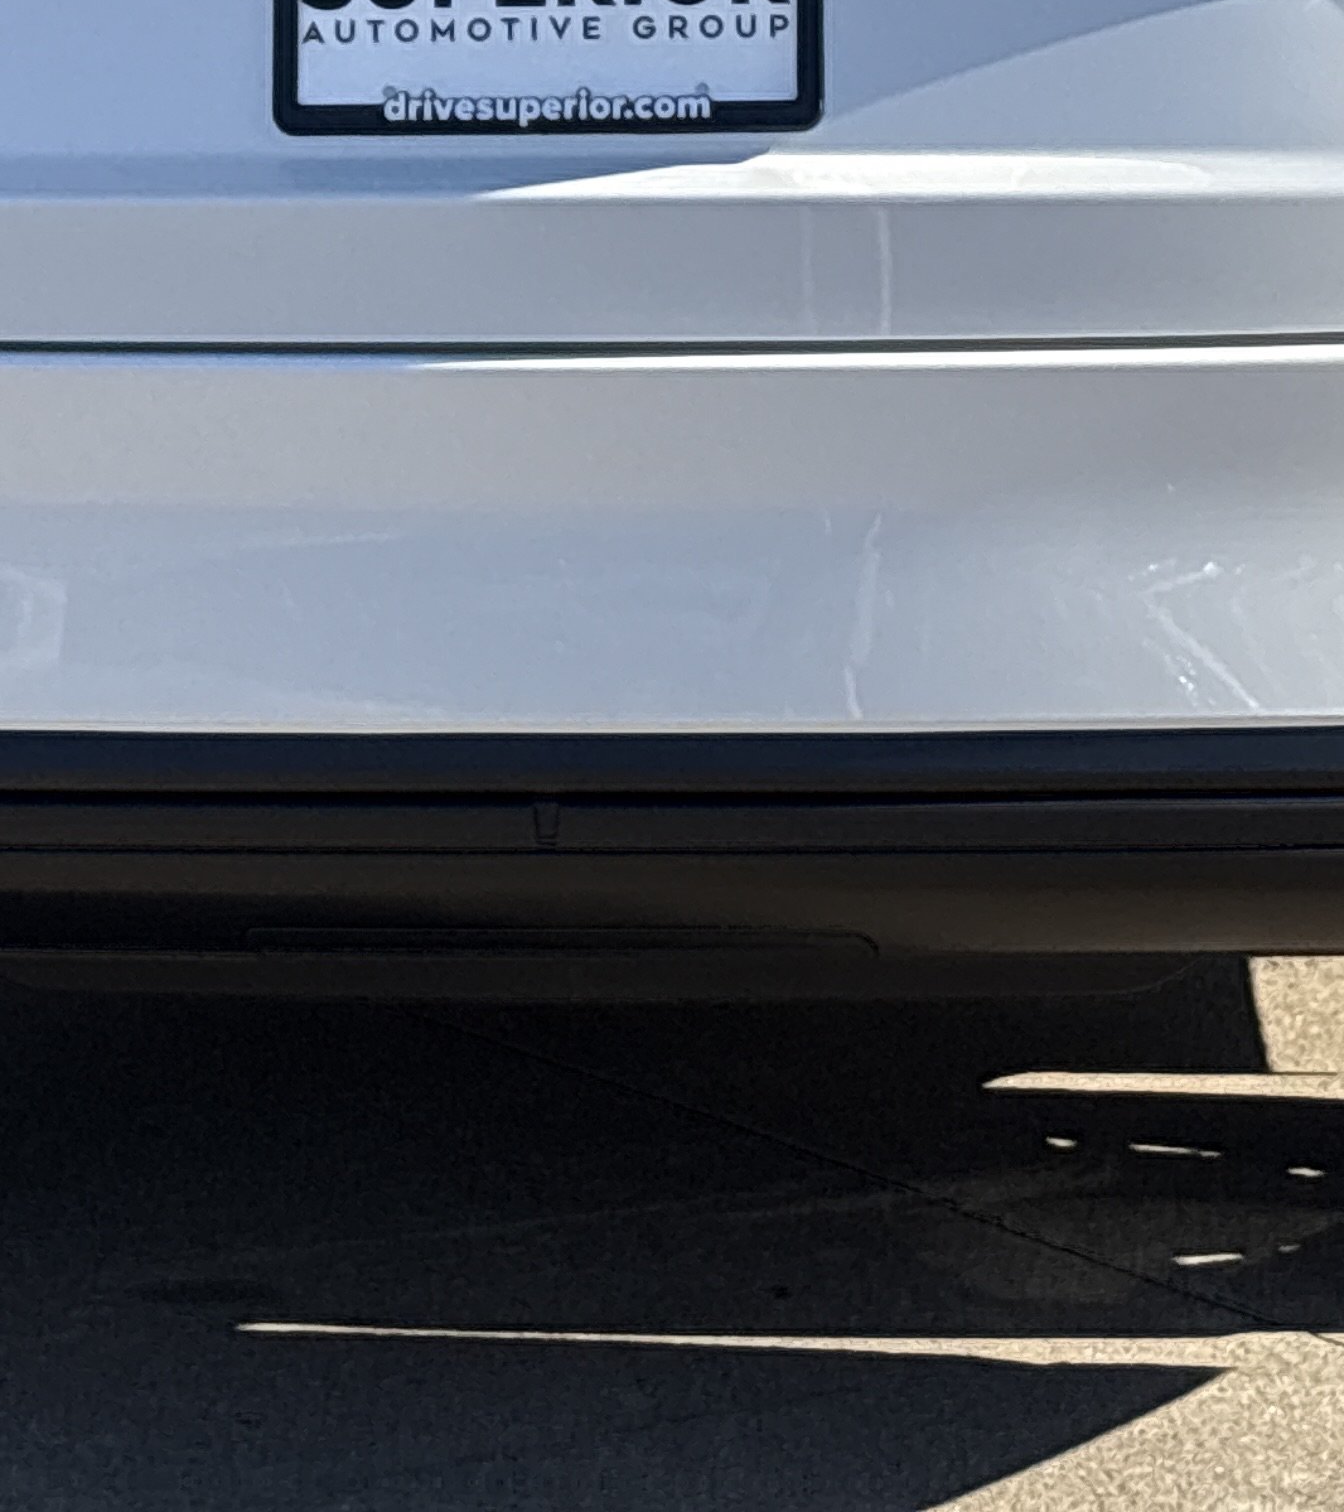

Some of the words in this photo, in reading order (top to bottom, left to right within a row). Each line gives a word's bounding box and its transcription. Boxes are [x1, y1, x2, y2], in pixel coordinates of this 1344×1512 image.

[302, 14, 602, 44] AUTOMOTIVE
[633, 14, 790, 39] GROUP
[383, 87, 711, 128] drivesuperior.com
